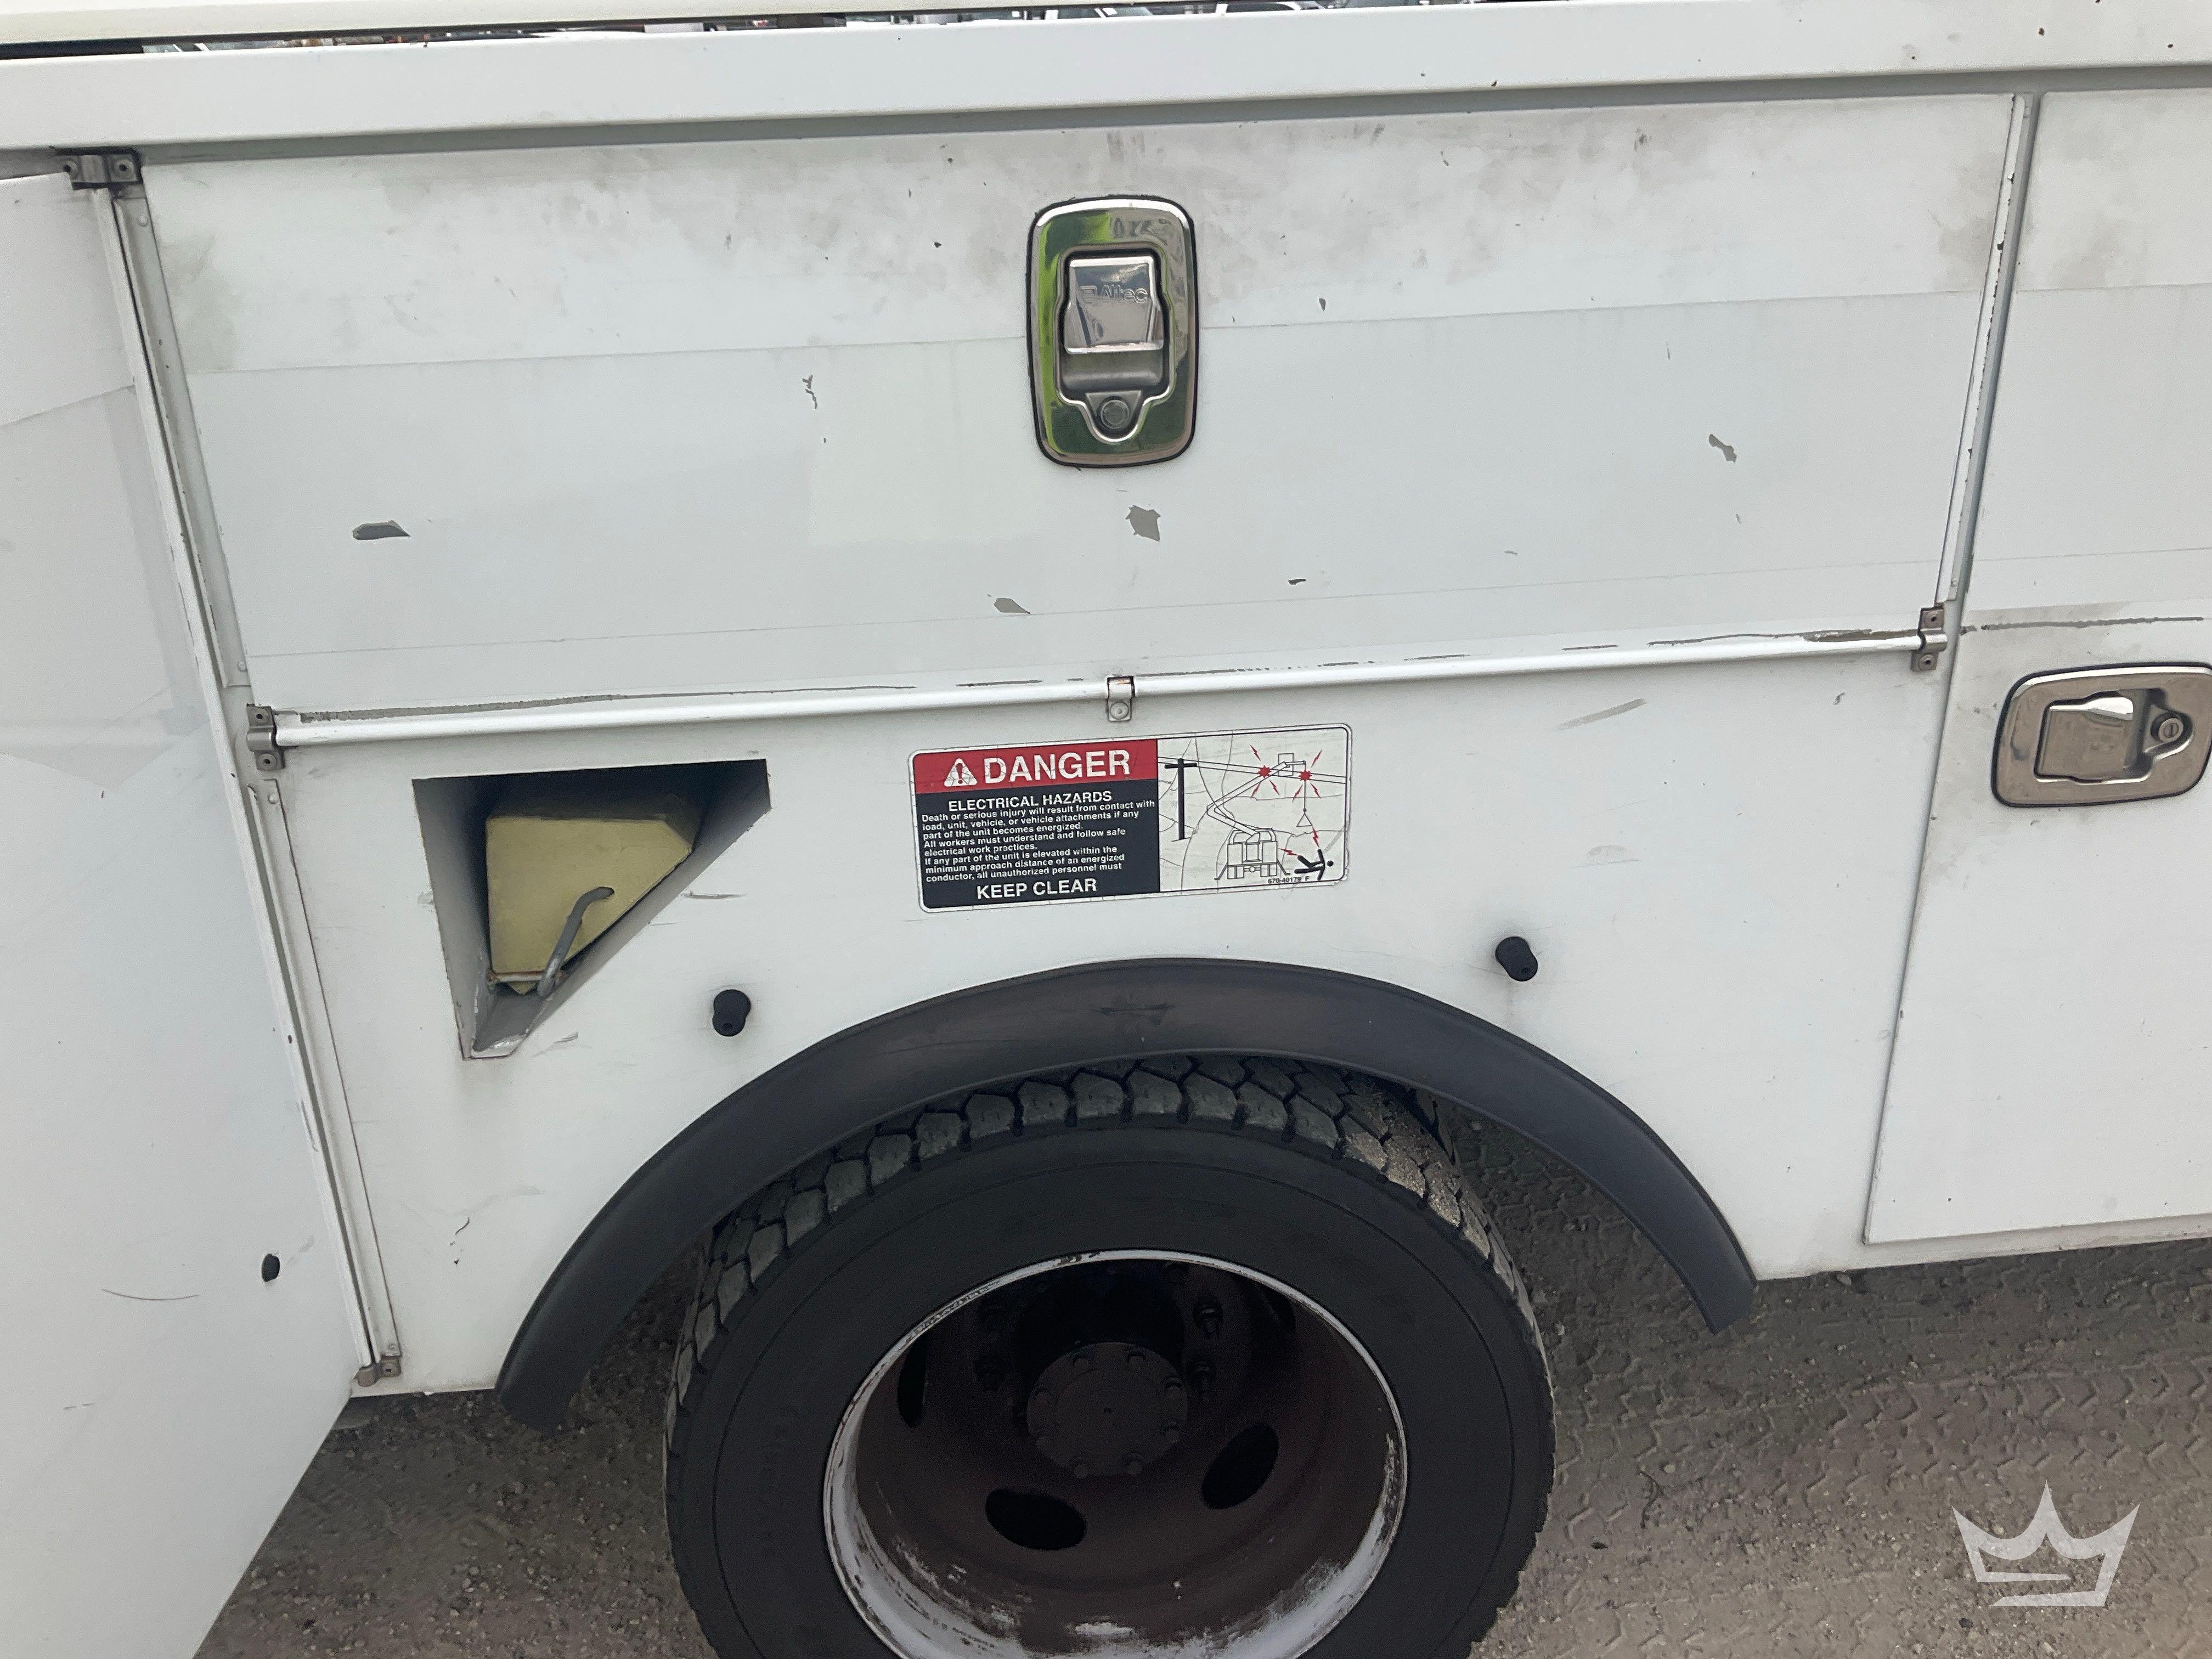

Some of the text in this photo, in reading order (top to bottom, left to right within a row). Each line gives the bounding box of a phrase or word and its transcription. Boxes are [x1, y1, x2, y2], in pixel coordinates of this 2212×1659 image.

[1101, 284, 1148, 304] Altec
[984, 749, 1130, 783] DANGER
[949, 791, 1112, 811] ELECTRICAL HAZARDS
[922, 813, 949, 823] Death
[963, 811, 998, 820] serious
[1000, 809, 1026, 819] injury
[1029, 806, 1045, 815] will
[1047, 805, 1074, 814] result
[1099, 802, 1133, 810] contact
[1136, 800, 1155, 808] with
[922, 822, 945, 831] load,
[947, 821, 968, 830] unit,
[970, 819, 1006, 827] vehicle,
[1008, 817, 1018, 825] or
[1020, 815, 1053, 825] vehicle
[1056, 812, 1111, 822] attachments
[923, 831, 941, 842] part
[973, 828, 991, 836] unit
[992, 826, 1034, 835] becomes
[1036, 822, 1084, 832] energized.
[924, 828, 1126, 848] All workers must understand and follow safe
[924, 843, 1037, 857] electrical work practices.
[952, 855, 971, 865] part
[1002, 852, 1020, 860] unit
[1032, 848, 1070, 858] elevated
[1073, 847, 1100, 855] within
[1102, 845, 1118, 854] the
[926, 865, 967, 874] minimum
[969, 861, 1013, 872] approach
[1014, 859, 1053, 868] distance
[1081, 853, 1125, 864] energized
[926, 862, 1122, 882] conductor, all unauthorized personnel must
[977, 878, 1097, 899] KEEP CLEAR
